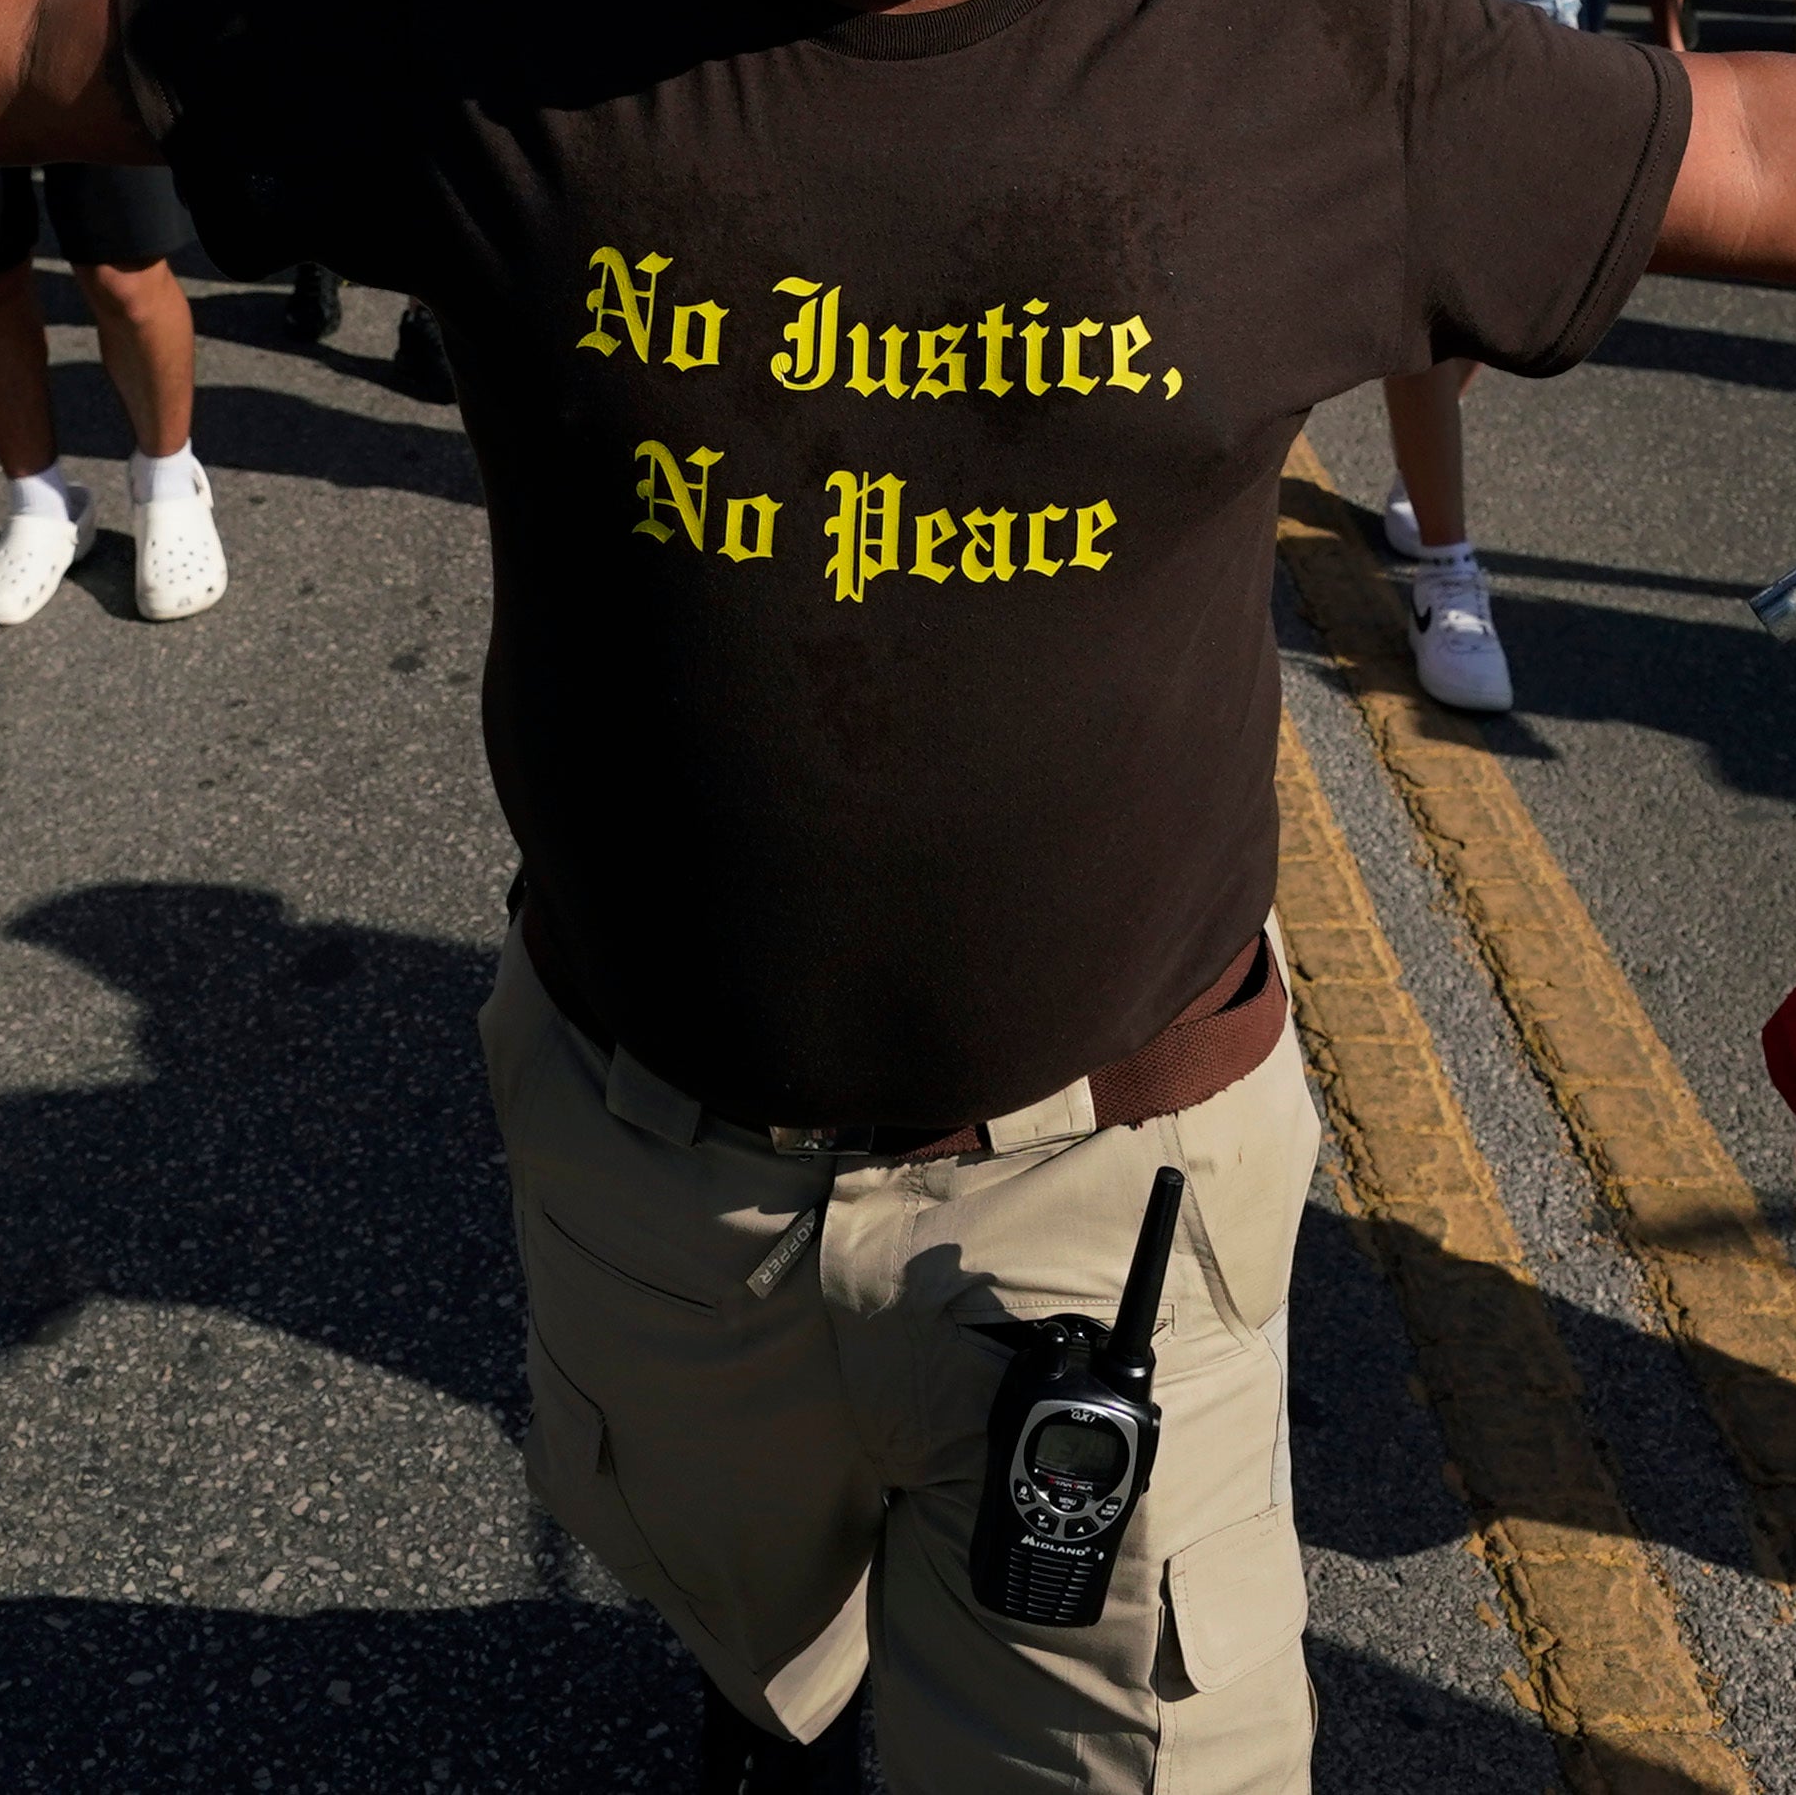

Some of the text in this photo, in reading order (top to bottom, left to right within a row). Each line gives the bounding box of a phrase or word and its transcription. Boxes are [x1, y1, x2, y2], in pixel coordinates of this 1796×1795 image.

[575, 245, 1184, 401] No Justice,
[631, 439, 1119, 604] No Peace
[1020, 1535, 1087, 1557] MIDLAND
